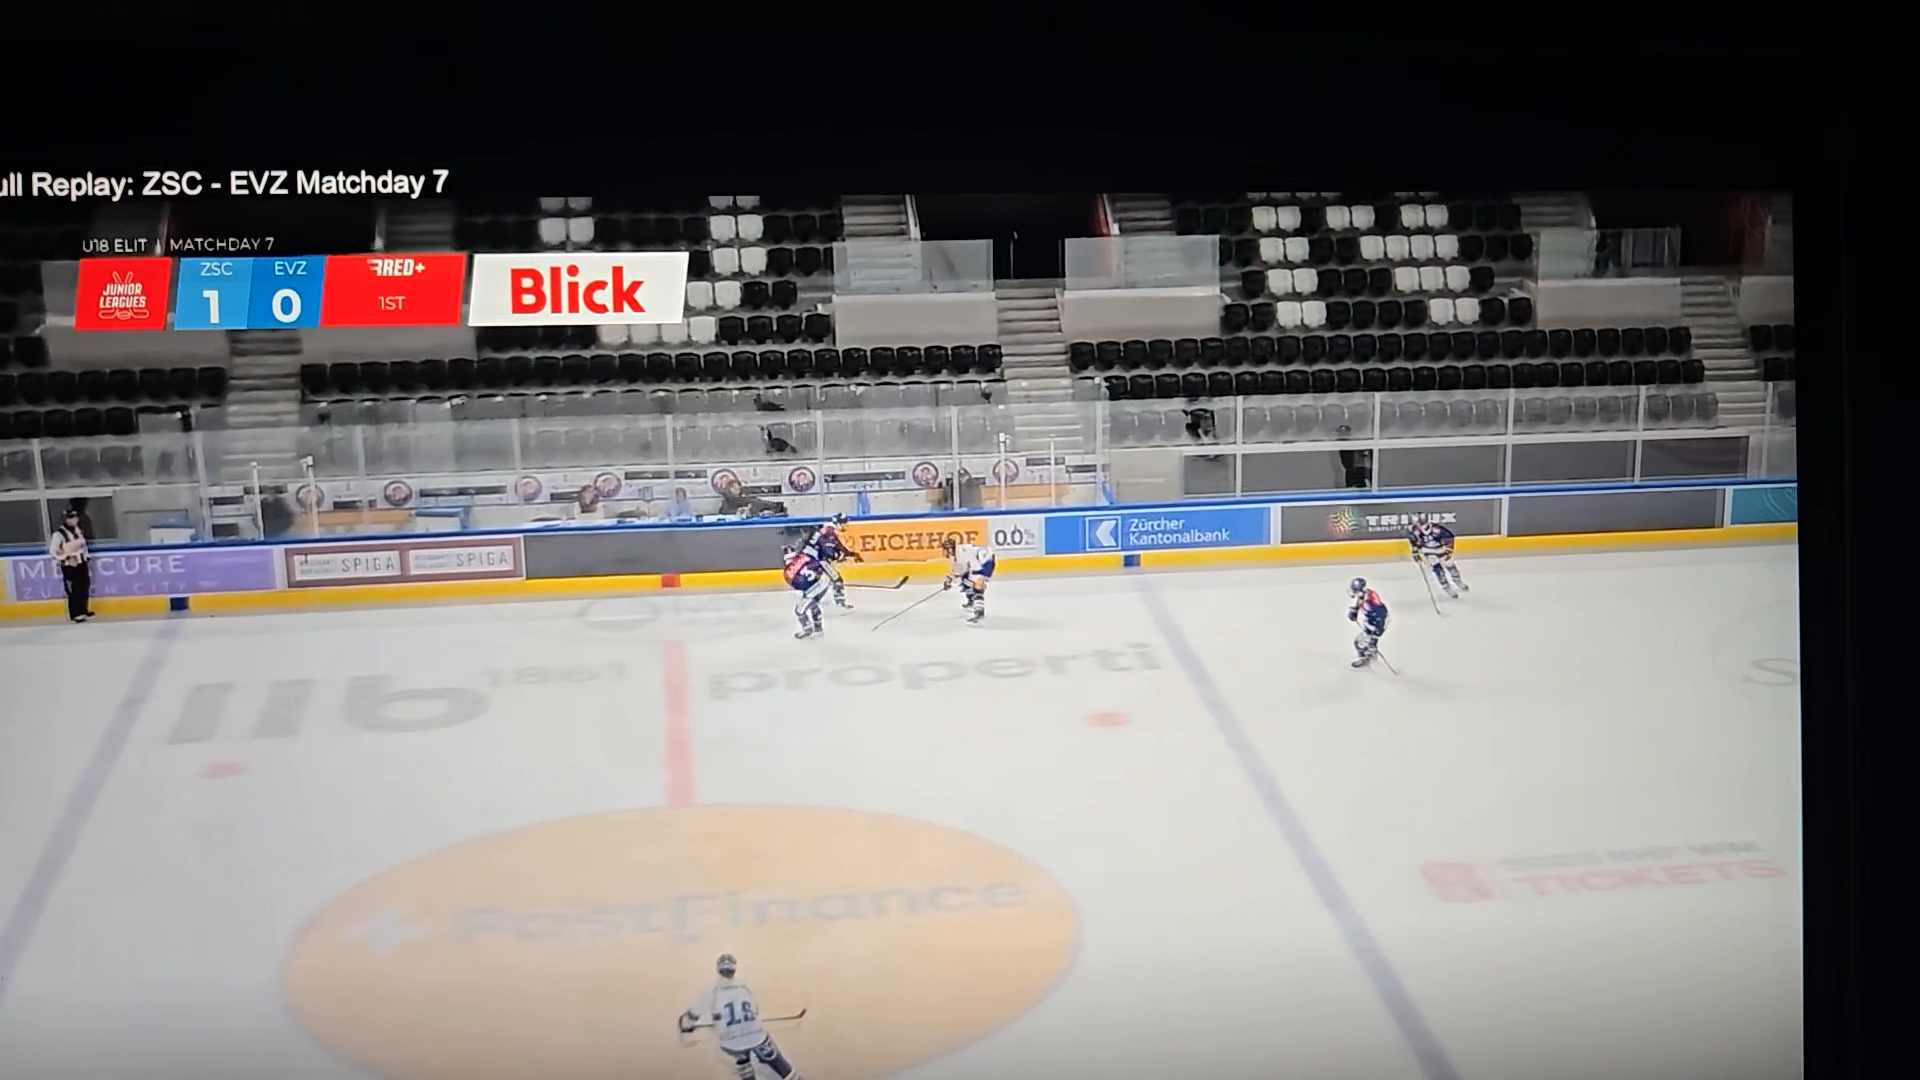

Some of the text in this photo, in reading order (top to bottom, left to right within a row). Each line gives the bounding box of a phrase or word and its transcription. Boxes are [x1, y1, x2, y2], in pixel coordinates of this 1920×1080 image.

[32, 171, 134, 202] Replay:
[142, 170, 203, 196] ZSC
[230, 170, 289, 195] EVZ
[296, 169, 426, 199] Matchday
[432, 168, 450, 193] 7
[82, 236, 275, 252] U18 ELIT MATCHDAY 7
[200, 261, 308, 277] ZSC EVZ
[103, 283, 143, 297] JUNIOR
[510, 264, 647, 315] Blick
[99, 296, 147, 310] LEAGUES
[202, 288, 302, 324] 1 0
[378, 295, 407, 311] 1ST
[1129, 517, 1186, 532] Zürcher
[1365, 512, 1457, 526] TRIUX
[1129, 528, 1231, 546] Kantonalbank
[18, 554, 187, 580] MECURE
[341, 553, 396, 573] SPIGA
[456, 550, 509, 568] SPIGA
[706, 643, 1163, 700] properti
[1502, 858, 1786, 897] TICKETS
